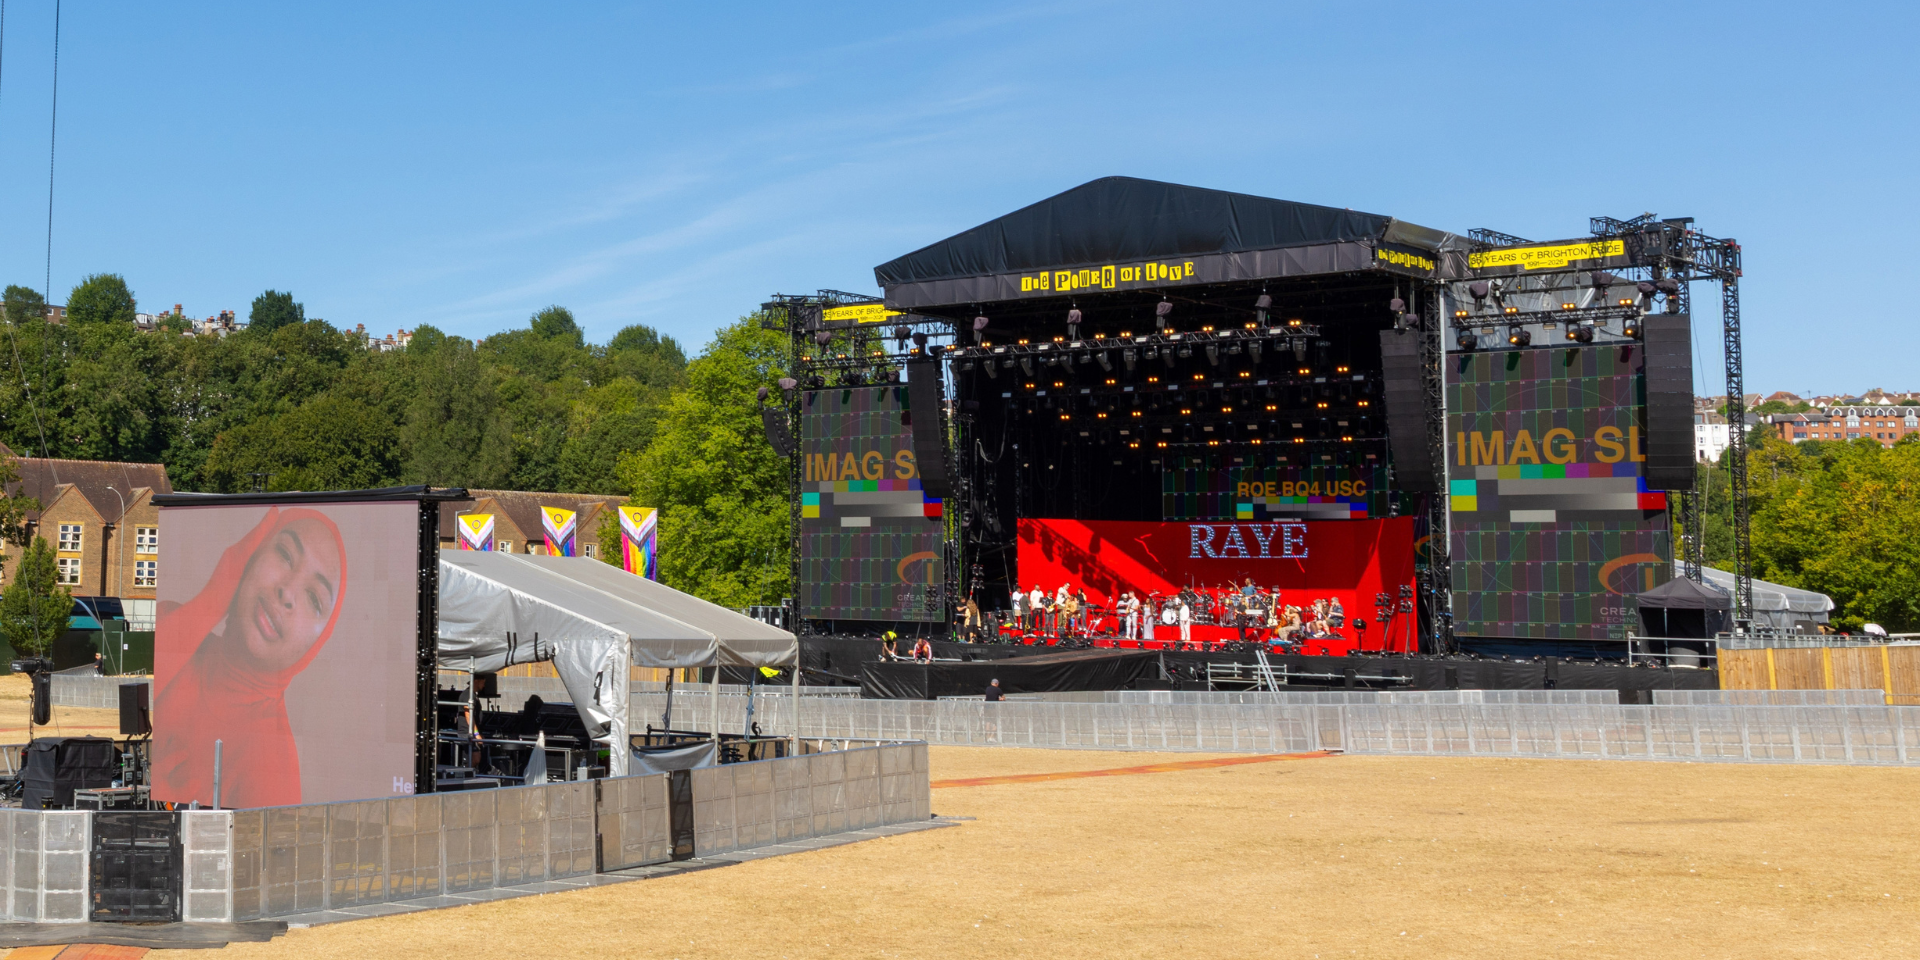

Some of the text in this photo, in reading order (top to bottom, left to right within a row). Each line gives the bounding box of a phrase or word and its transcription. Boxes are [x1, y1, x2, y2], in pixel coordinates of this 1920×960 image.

[1485, 253, 1516, 263] YEARS
[1521, 252, 1534, 260] OF
[1537, 247, 1587, 258] BRIGHTON
[1590, 244, 1621, 255] PRIDE
[1021, 271, 1049, 291] Te
[1120, 267, 1141, 281] OF
[1146, 262, 1194, 281] LOVE
[832, 309, 853, 318] YEARS
[855, 308, 864, 316] OF
[1457, 426, 1646, 466] IMAG SL
[806, 450, 921, 482] IMAG S
[1237, 481, 1277, 497] ROE
[1282, 480, 1320, 497] BQ4
[1326, 480, 1367, 497] USC
[1188, 523, 1308, 558] RAYE
[393, 776, 414, 794] He
